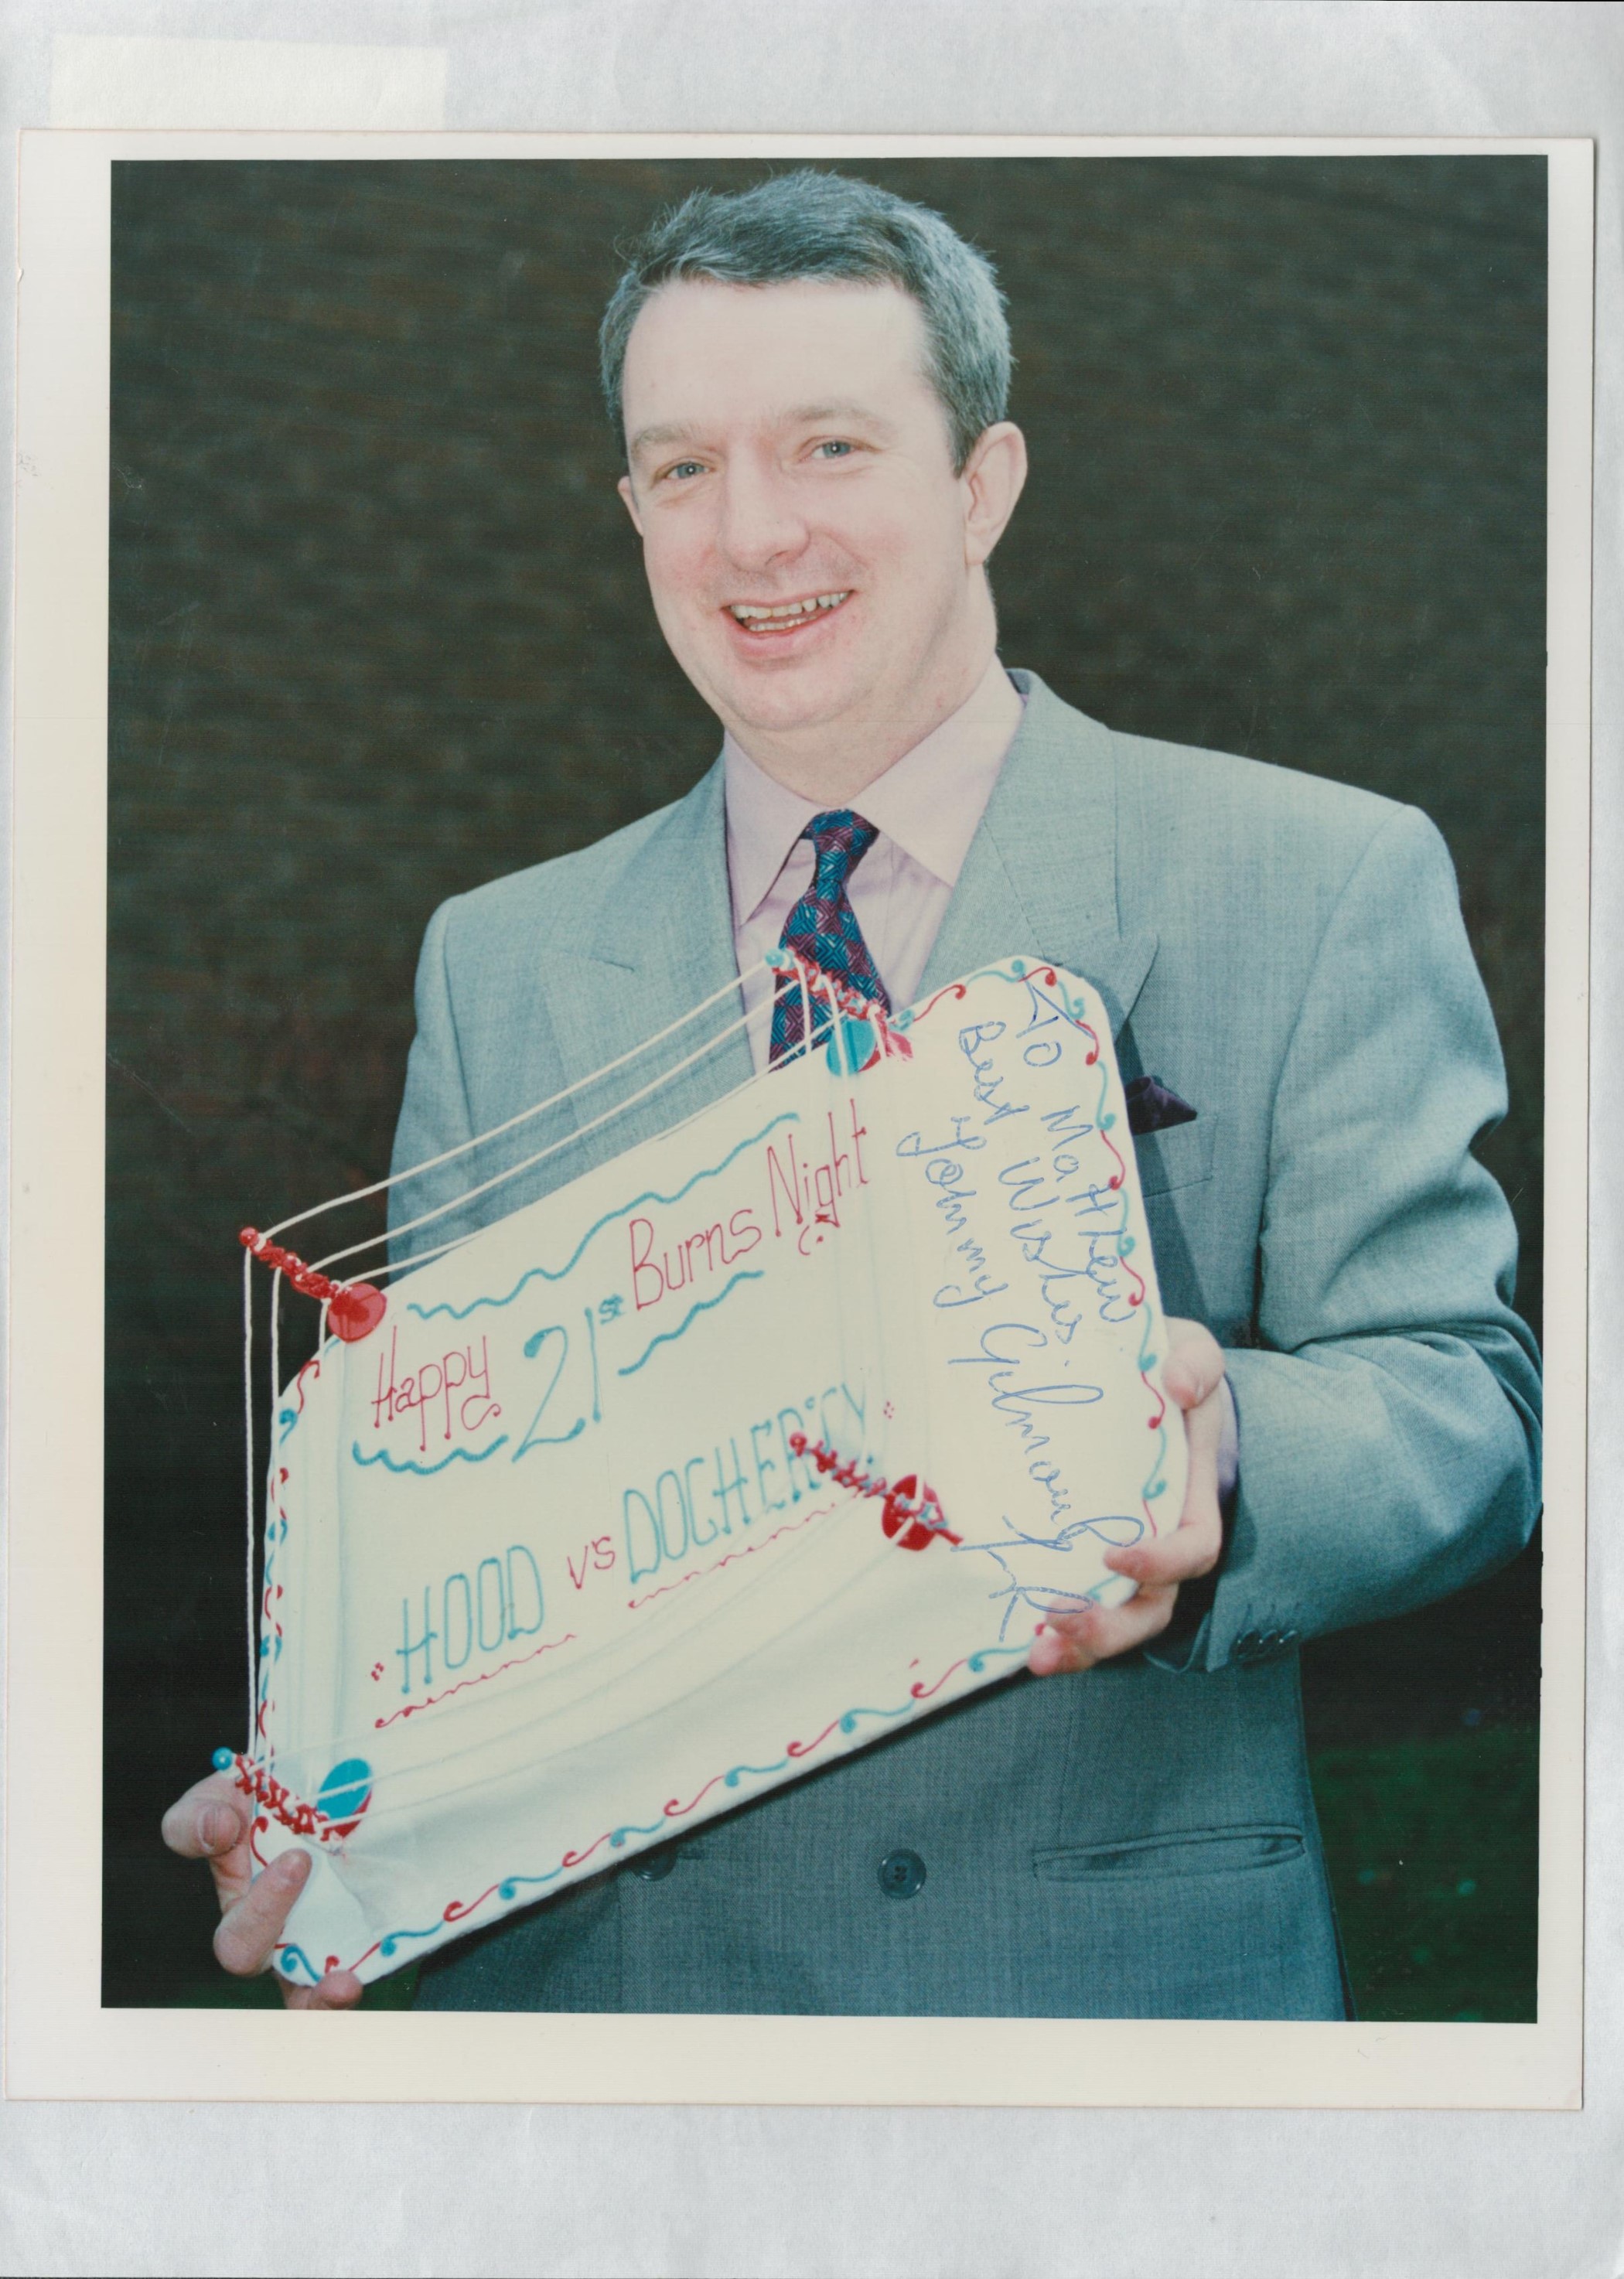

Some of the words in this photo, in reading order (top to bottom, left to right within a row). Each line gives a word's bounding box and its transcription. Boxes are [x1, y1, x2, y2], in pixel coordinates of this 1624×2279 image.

[959, 1021, 1030, 1125] Best
[371, 1325, 501, 1452] Happy
[511, 1294, 624, 1463] 21st
[629, 1208, 762, 1312] Burns
[766, 1097, 870, 1256] Night
[395, 1545, 544, 1694] HOOD
